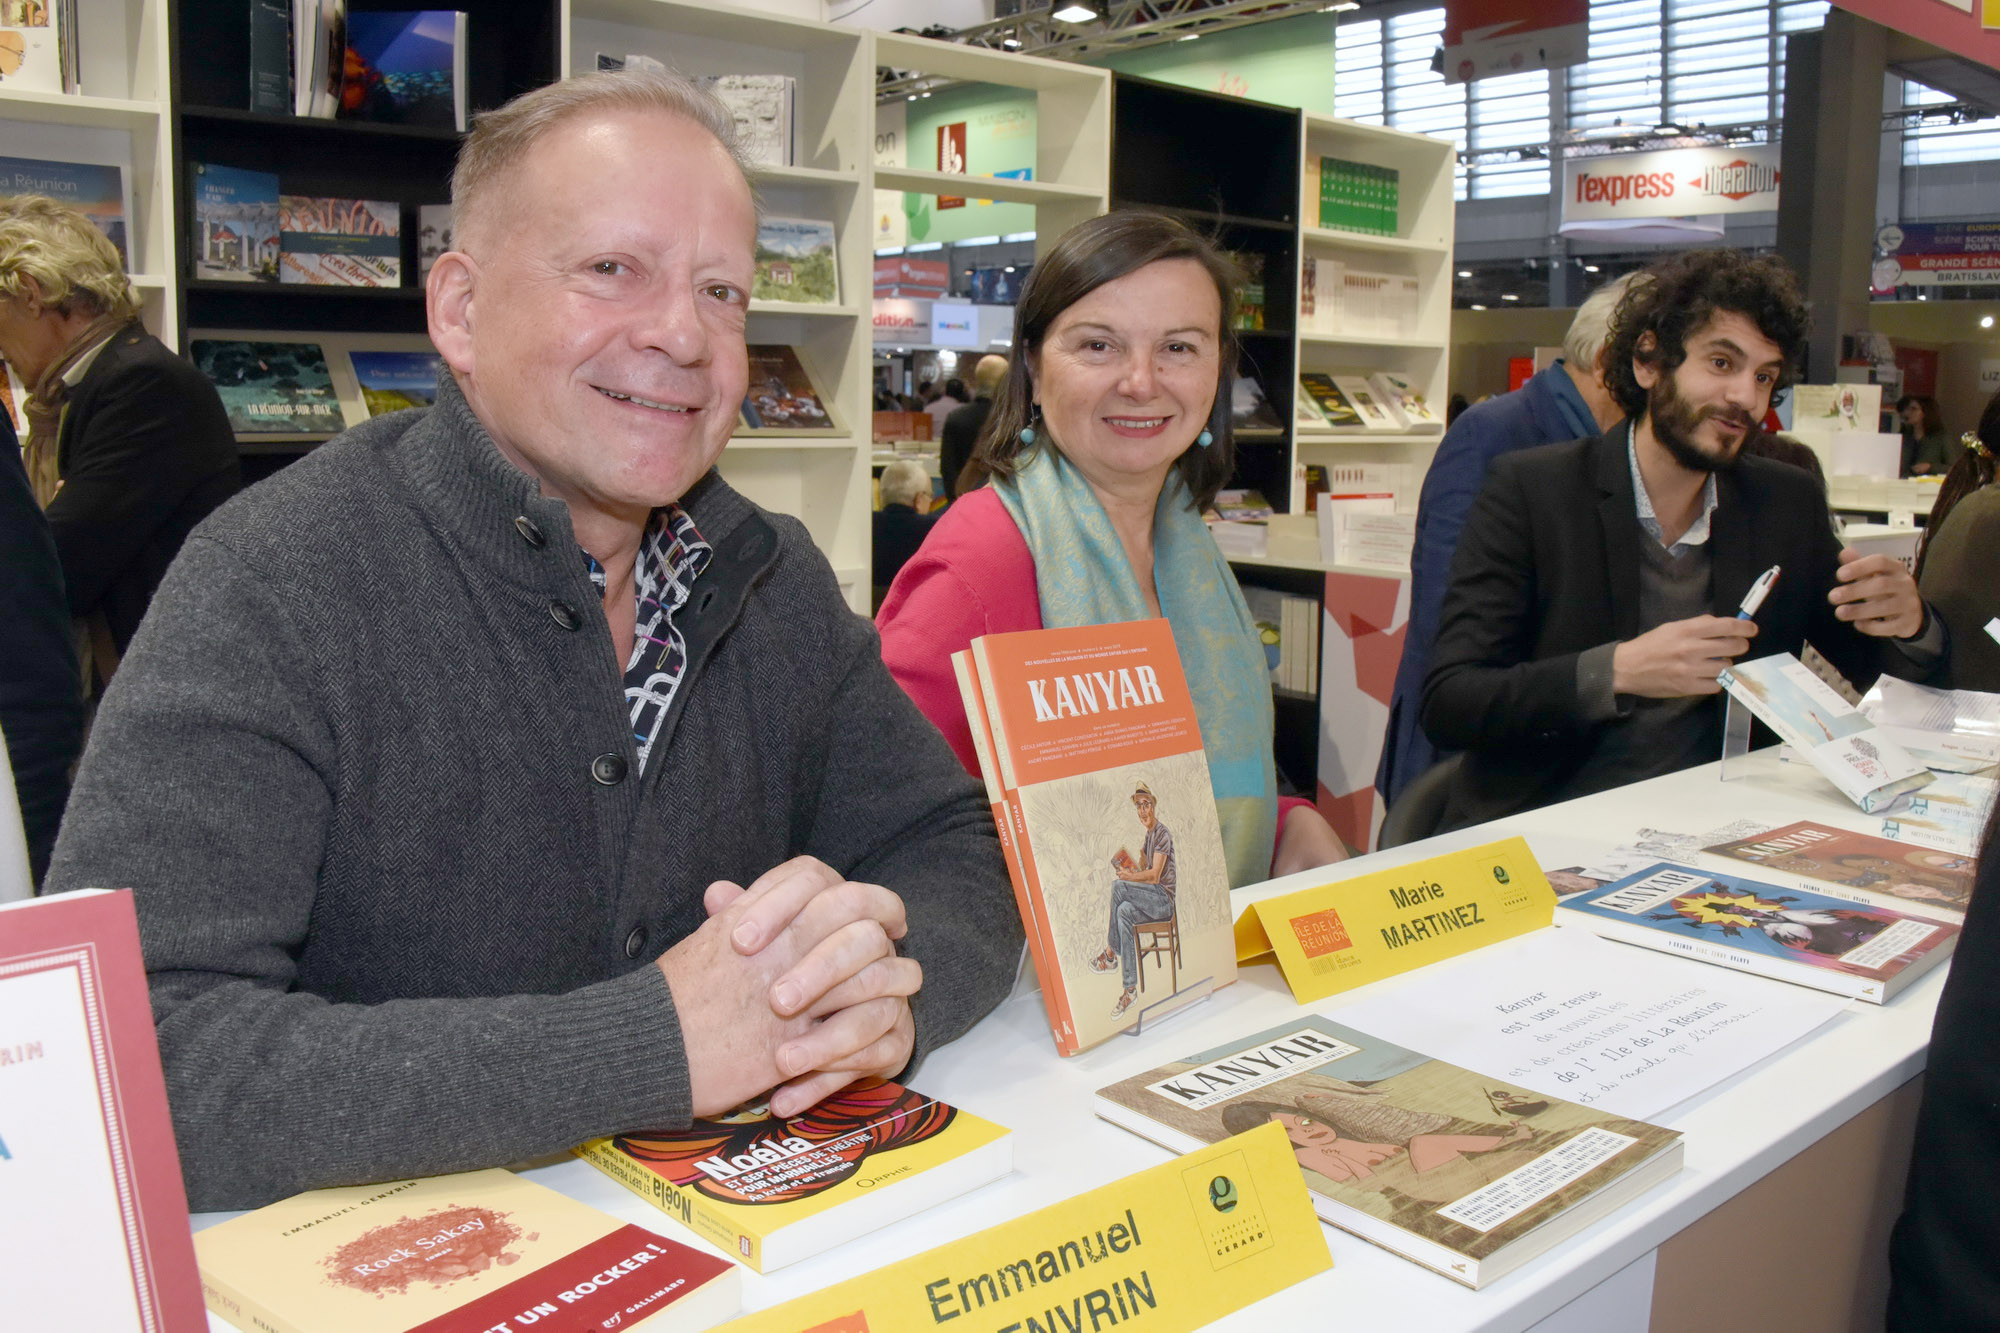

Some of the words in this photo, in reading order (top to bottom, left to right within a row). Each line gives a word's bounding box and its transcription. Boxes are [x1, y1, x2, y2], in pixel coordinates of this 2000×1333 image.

[14, 173, 78, 192] Réunion
[1577, 172, 1675, 207] l'express
[1920, 258, 1968, 268] GRANDE
[1937, 271, 2000, 281] BRATISLAV
[1027, 664, 1165, 723] KANYAR
[998, 818, 1009, 846] KANYAR
[1013, 804, 1023, 833] KANYAR
[1737, 829, 1831, 857] KANYAR
[1389, 881, 1446, 910] Marie
[1599, 872, 1694, 909] KANYAR
[1301, 930, 1349, 952] RÉUNION
[1312, 920, 1328, 934] DE
[1328, 918, 1344, 929] LA
[1380, 902, 1485, 951] MARTINEZ
[1495, 989, 1548, 1016] Kanyar
[1500, 1020, 1524, 1035] est
[1531, 1006, 1561, 1022] une
[1560, 989, 1602, 1010] revue
[1054, 1028, 1064, 1043] K
[1062, 1020, 1073, 1035] K
[1508, 1065, 1532, 1078] et
[1533, 1050, 1556, 1067] de
[1556, 1018, 1630, 1056] créations
[1630, 985, 1708, 1024] littéraires
[1536, 1028, 1558, 1043] de
[1559, 998, 1630, 1033] nouvelles
[0, 1041, 44, 1067] RIN
[1556, 1068, 1580, 1084] de
[1600, 1044, 1630, 1062] île
[1632, 1031, 1655, 1048] de
[1654, 1022, 1677, 1039] La
[1671, 999, 1728, 1029] Réunion
[1160, 1034, 1337, 1101] KANYAR
[1579, 1090, 1600, 1105] et
[1600, 1081, 1620, 1094] du
[1619, 1055, 1667, 1082] monde
[1668, 1041, 1694, 1057] qui
[601, 1158, 610, 1170] DE
[609, 1161, 628, 1184] PIÈCES
[693, 1135, 816, 1182] Noéla
[724, 1177, 742, 1189] ET
[744, 1168, 771, 1186] SEPT
[771, 1154, 811, 1174] PIÈCES
[809, 1149, 827, 1161] DE
[824, 1132, 874, 1154] THÉÂTRE
[628, 1173, 642, 1192] SEPT
[642, 1183, 650, 1195] ET
[736, 1178, 771, 1197] POUR
[770, 1155, 844, 1184] MARMAILLES
[748, 1190, 765, 1202] An
[765, 1181, 791, 1198] kréol
[790, 1178, 804, 1189] et
[801, 1173, 816, 1184] en
[814, 1161, 854, 1181] français
[856, 1165, 912, 1189] ORPHIE
[282, 1206, 357, 1237] EMMANUEL
[361, 1181, 418, 1206] GENVRIN
[652, 1177, 692, 1224] Noéla
[352, 1248, 417, 1277] Rock
[414, 1216, 486, 1251] Sakay
[424, 1248, 453, 1262] roman
[924, 1209, 1142, 1325] Emmanuel
[513, 1301, 559, 1326] UN
[602, 1311, 623, 1329] nrf
[625, 1278, 686, 1315] GALLIMARD
[997, 1270, 1157, 1333] NVRIN
